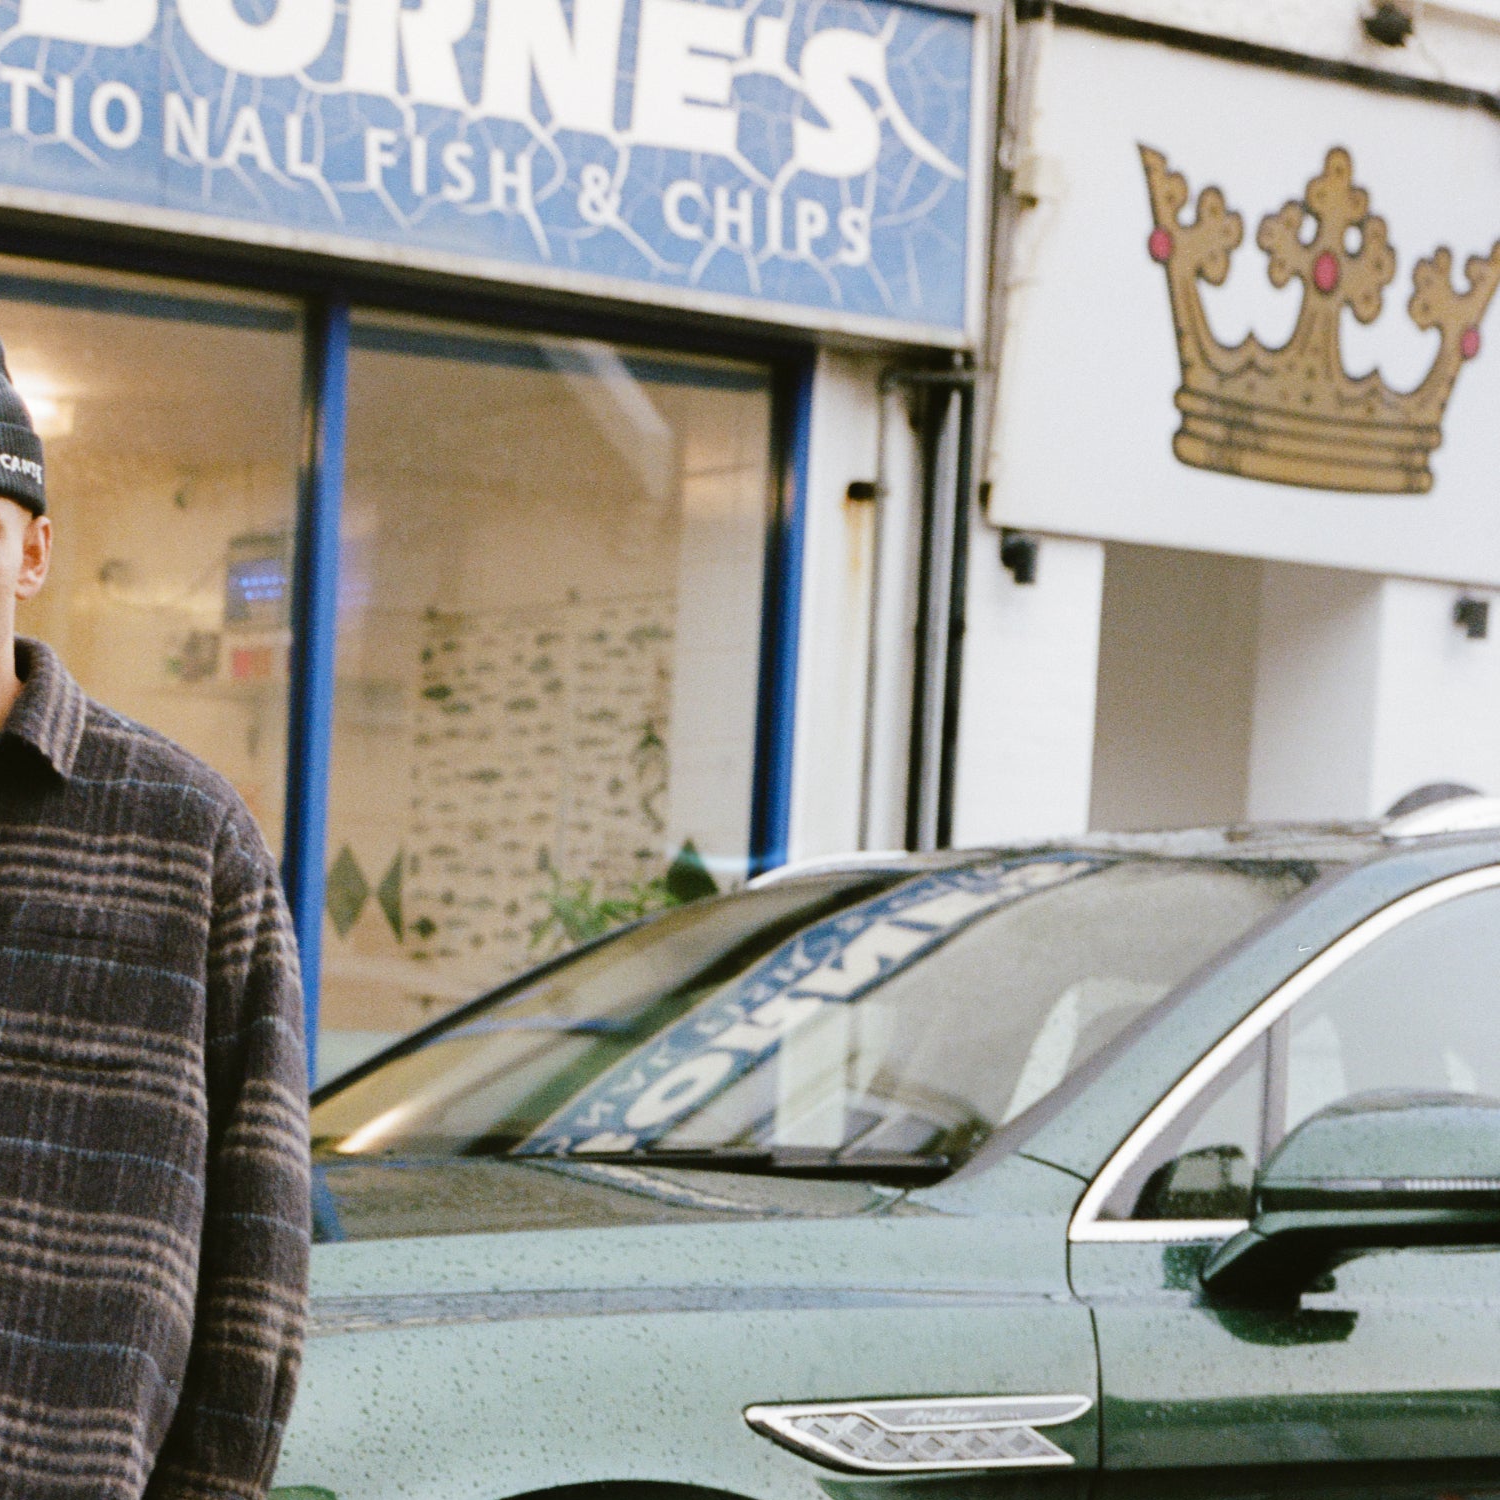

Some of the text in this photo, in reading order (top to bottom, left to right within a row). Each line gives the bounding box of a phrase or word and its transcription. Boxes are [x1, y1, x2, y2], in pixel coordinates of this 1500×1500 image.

[365, 128, 531, 210] FISH
[577, 163, 620, 226] &
[663, 180, 871, 267] CHIPS
